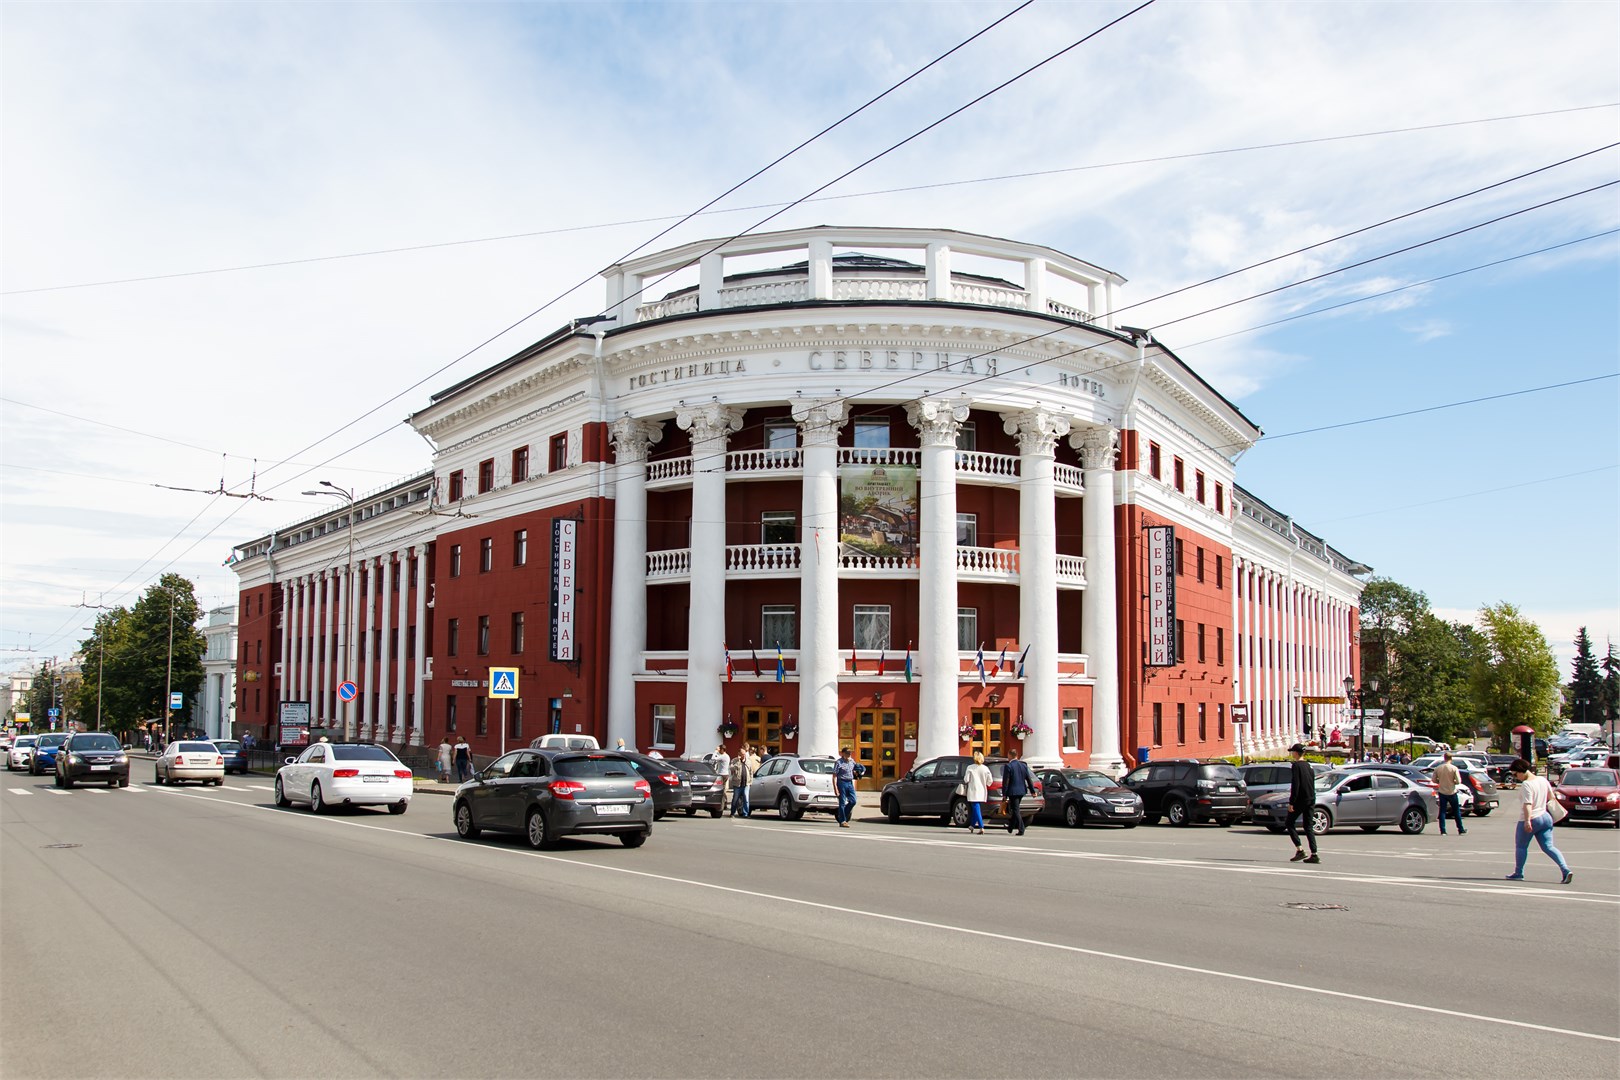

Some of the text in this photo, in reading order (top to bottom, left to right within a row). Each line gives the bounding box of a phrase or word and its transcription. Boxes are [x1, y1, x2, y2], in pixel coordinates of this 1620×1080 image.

[629, 350, 1105, 398] ГОСТИНИЦА СЕВЕРНАЯ HOTEL
[561, 523, 572, 658] СЕВЕРНАЯ
[1154, 531, 1164, 662] СЕВЕРНЫЙ
